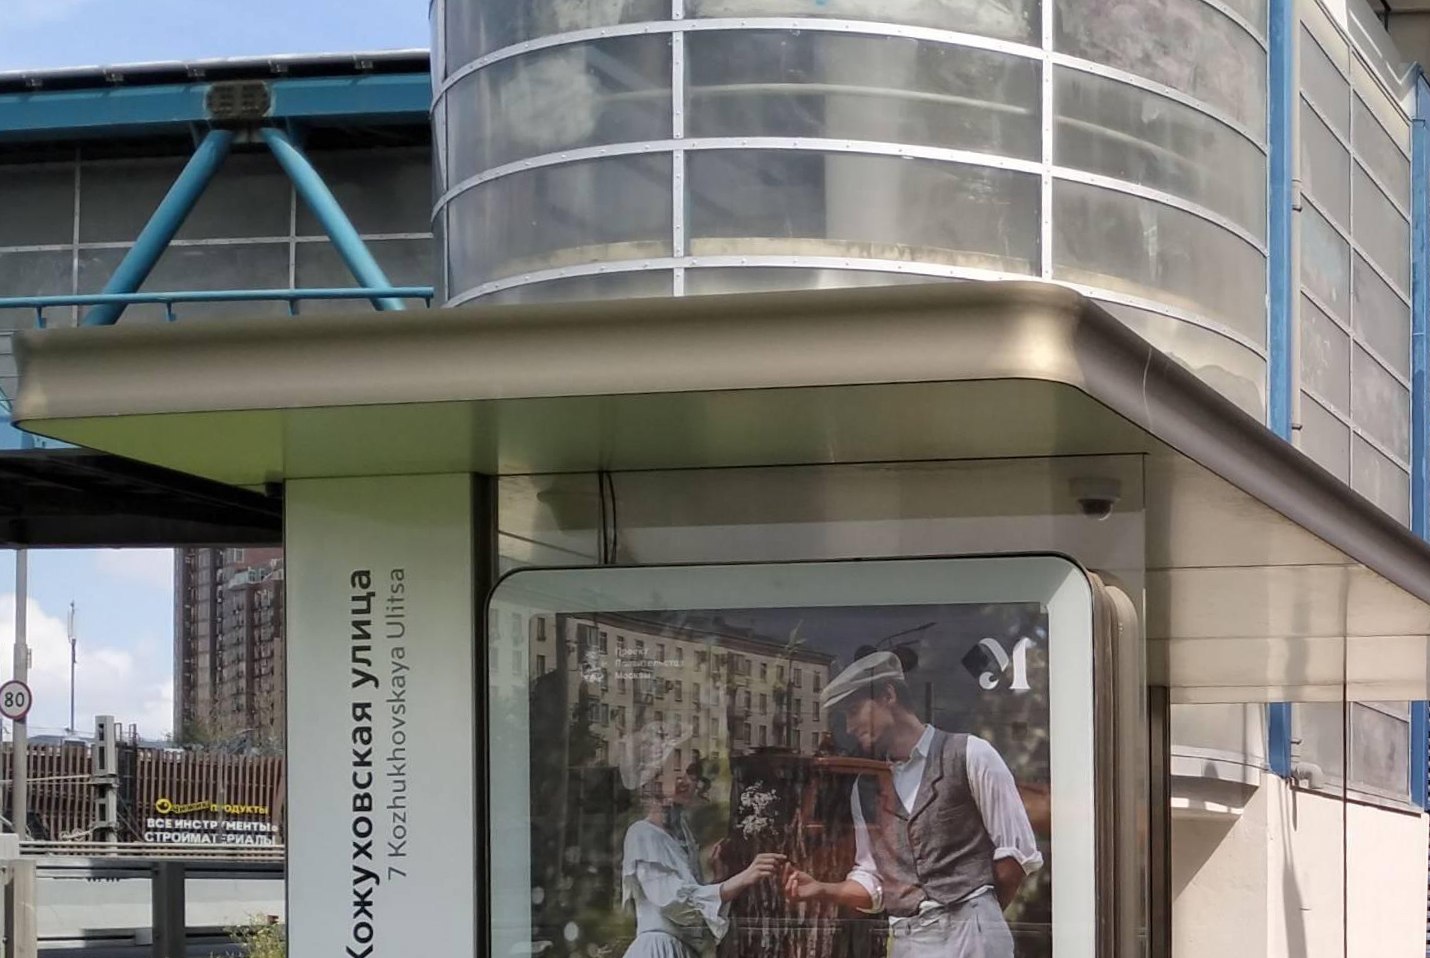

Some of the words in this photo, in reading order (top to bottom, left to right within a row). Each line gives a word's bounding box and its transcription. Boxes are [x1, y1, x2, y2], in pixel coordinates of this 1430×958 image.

[385, 568, 405, 638] Ulitsa
[350, 569, 379, 689] улица
[4, 691, 25, 708] 80
[386, 646, 410, 857] Kozhukhovskaya
[210, 803, 269, 815] ПОДУКТЫ
[146, 818, 173, 829] ВСЕ
[387, 866, 407, 880] 7
